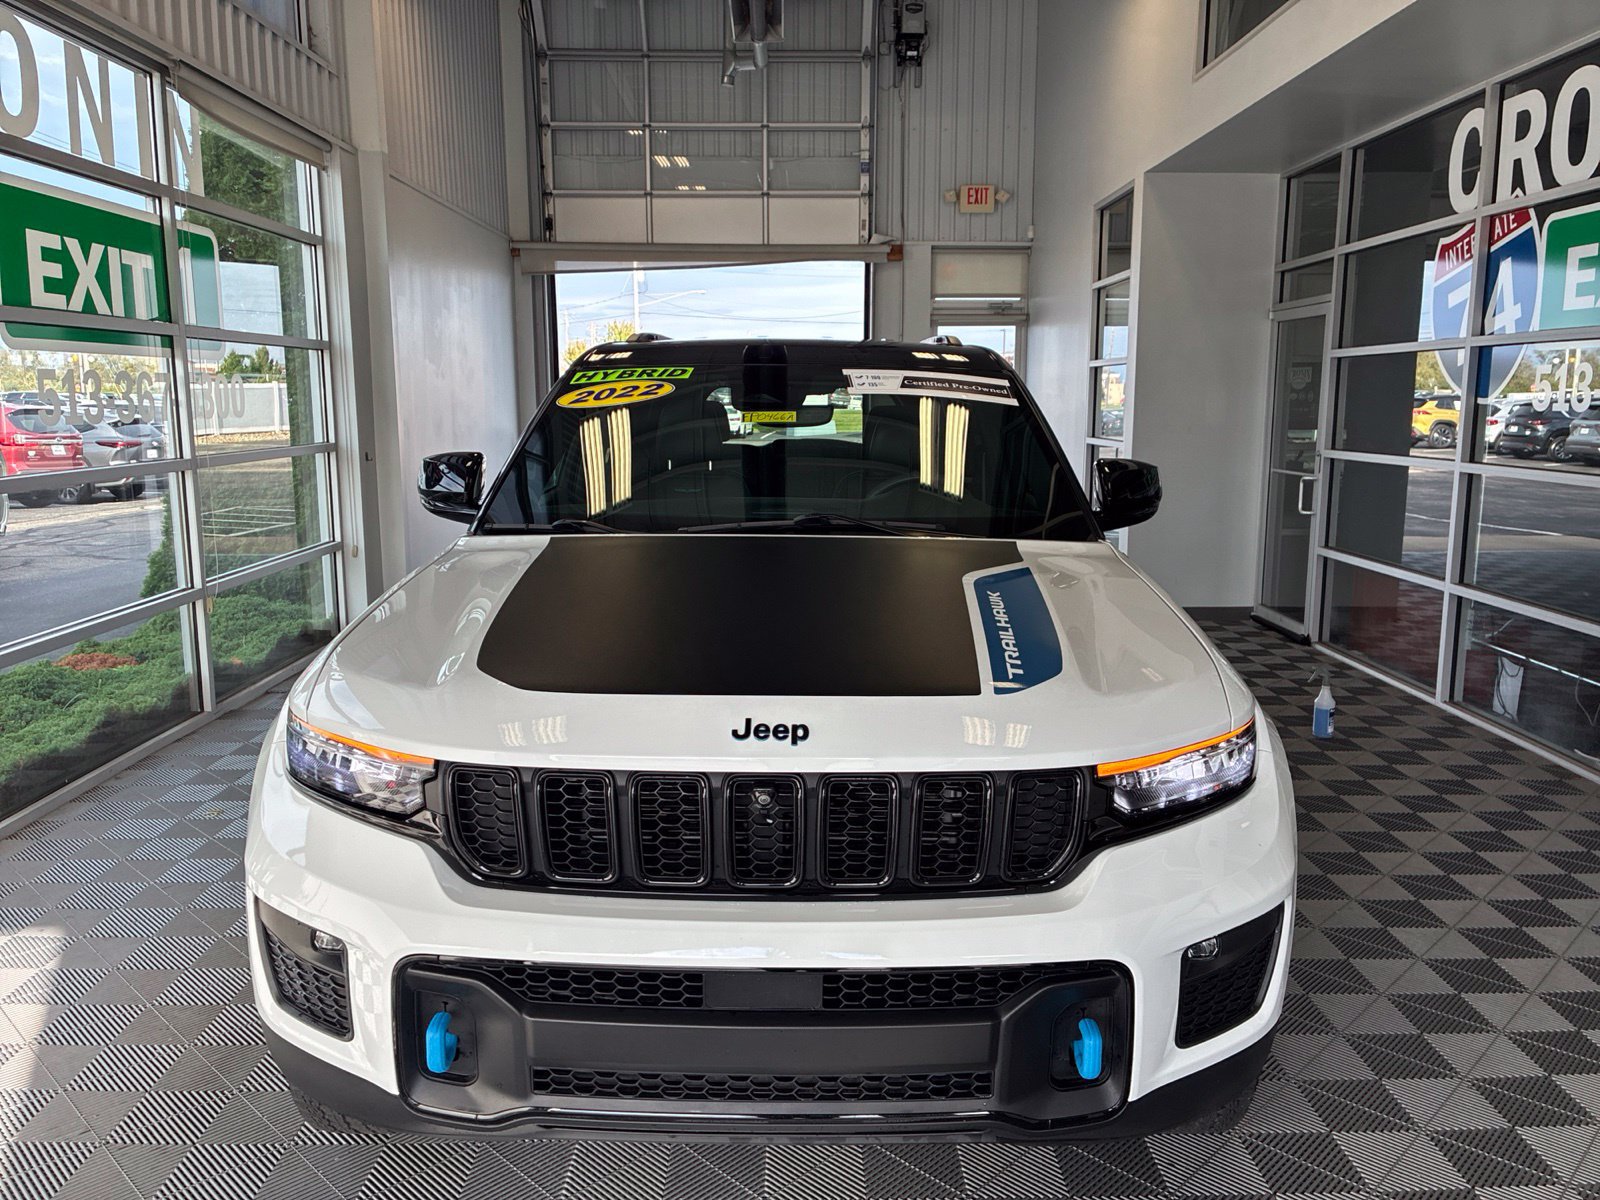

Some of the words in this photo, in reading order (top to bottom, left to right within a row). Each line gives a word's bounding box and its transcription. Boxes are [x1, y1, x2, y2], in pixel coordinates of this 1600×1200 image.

[1448, 64, 1600, 213] CRO
[967, 187, 989, 205] EXIT
[26, 228, 158, 321] EXIT
[1563, 243, 1600, 311] E
[574, 368, 689, 383] HYBRID
[904, 379, 949, 389] Certified
[952, 383, 1008, 395] Pre-Owned
[568, 383, 665, 405] 2022
[986, 590, 1025, 680] TRAILHAWK
[731, 717, 810, 746] Jeep
